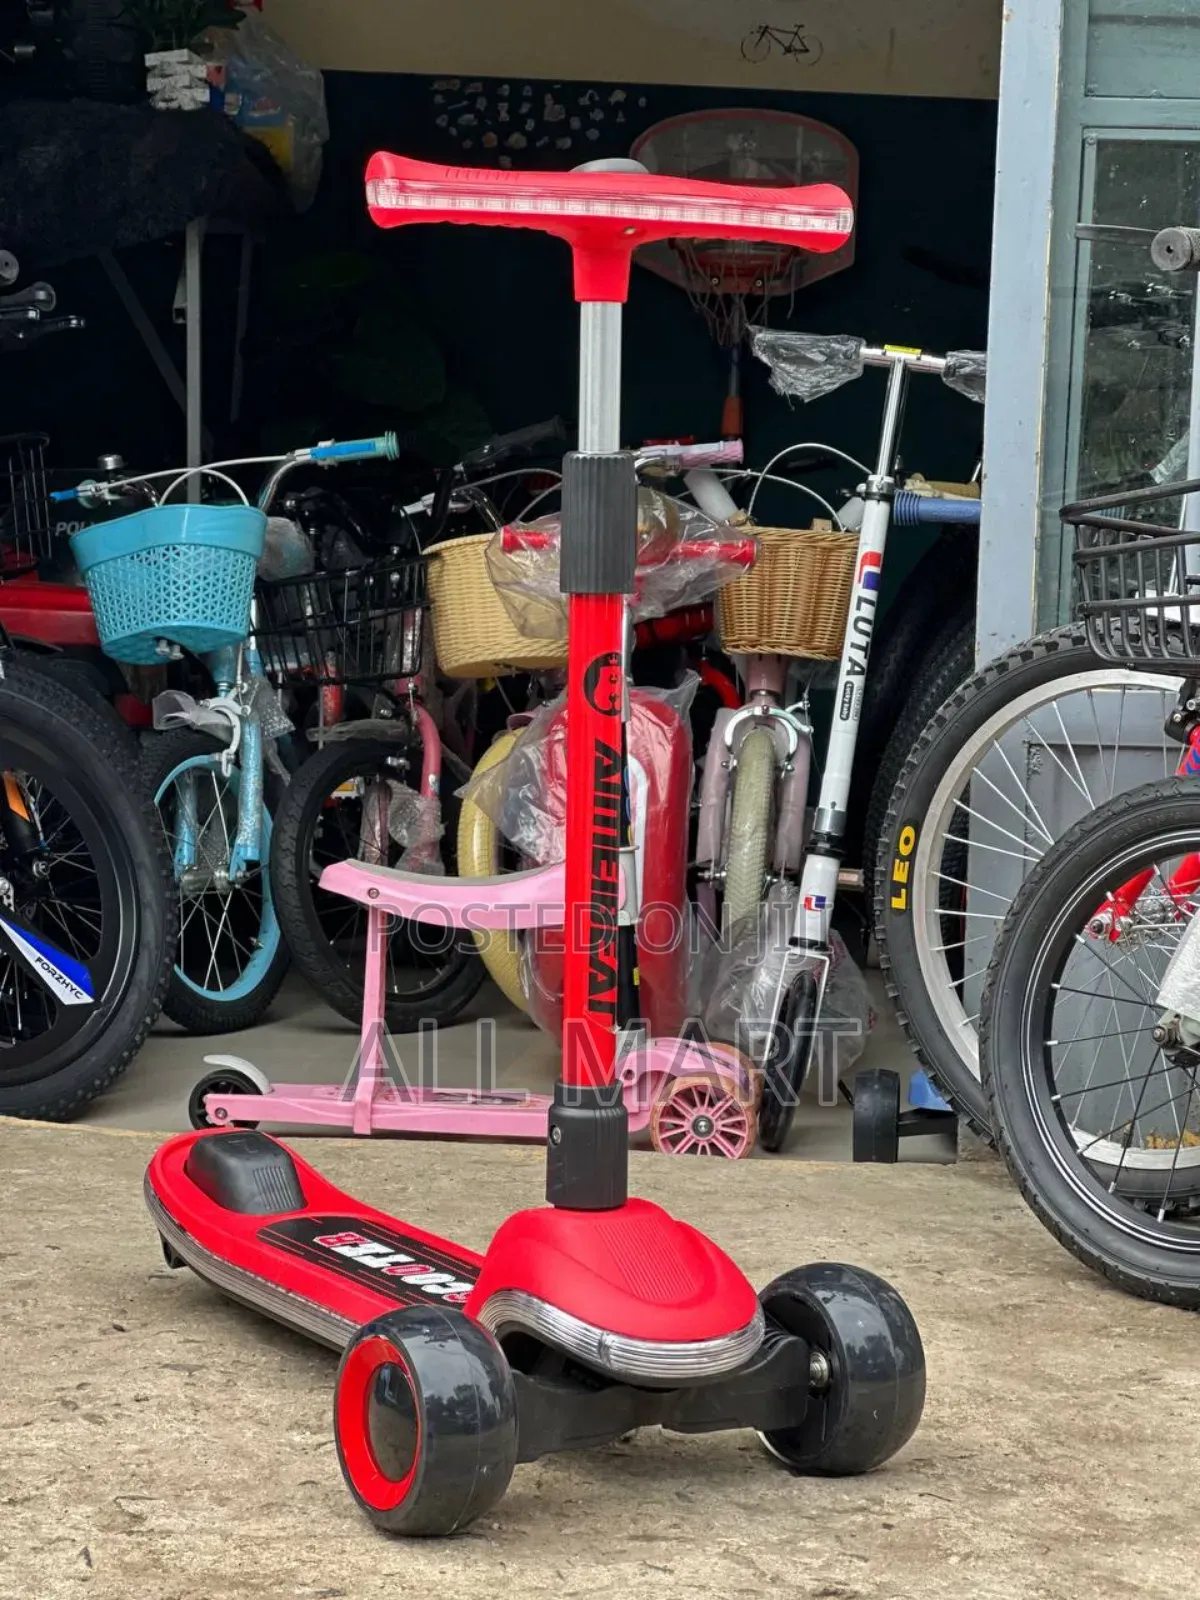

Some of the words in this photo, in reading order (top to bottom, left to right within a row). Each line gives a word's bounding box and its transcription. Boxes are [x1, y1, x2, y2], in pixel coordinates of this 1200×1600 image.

[846, 595, 876, 677] LUTA
[891, 825, 916, 910] LEO
[35, 956, 84, 1000] FORZHYC
